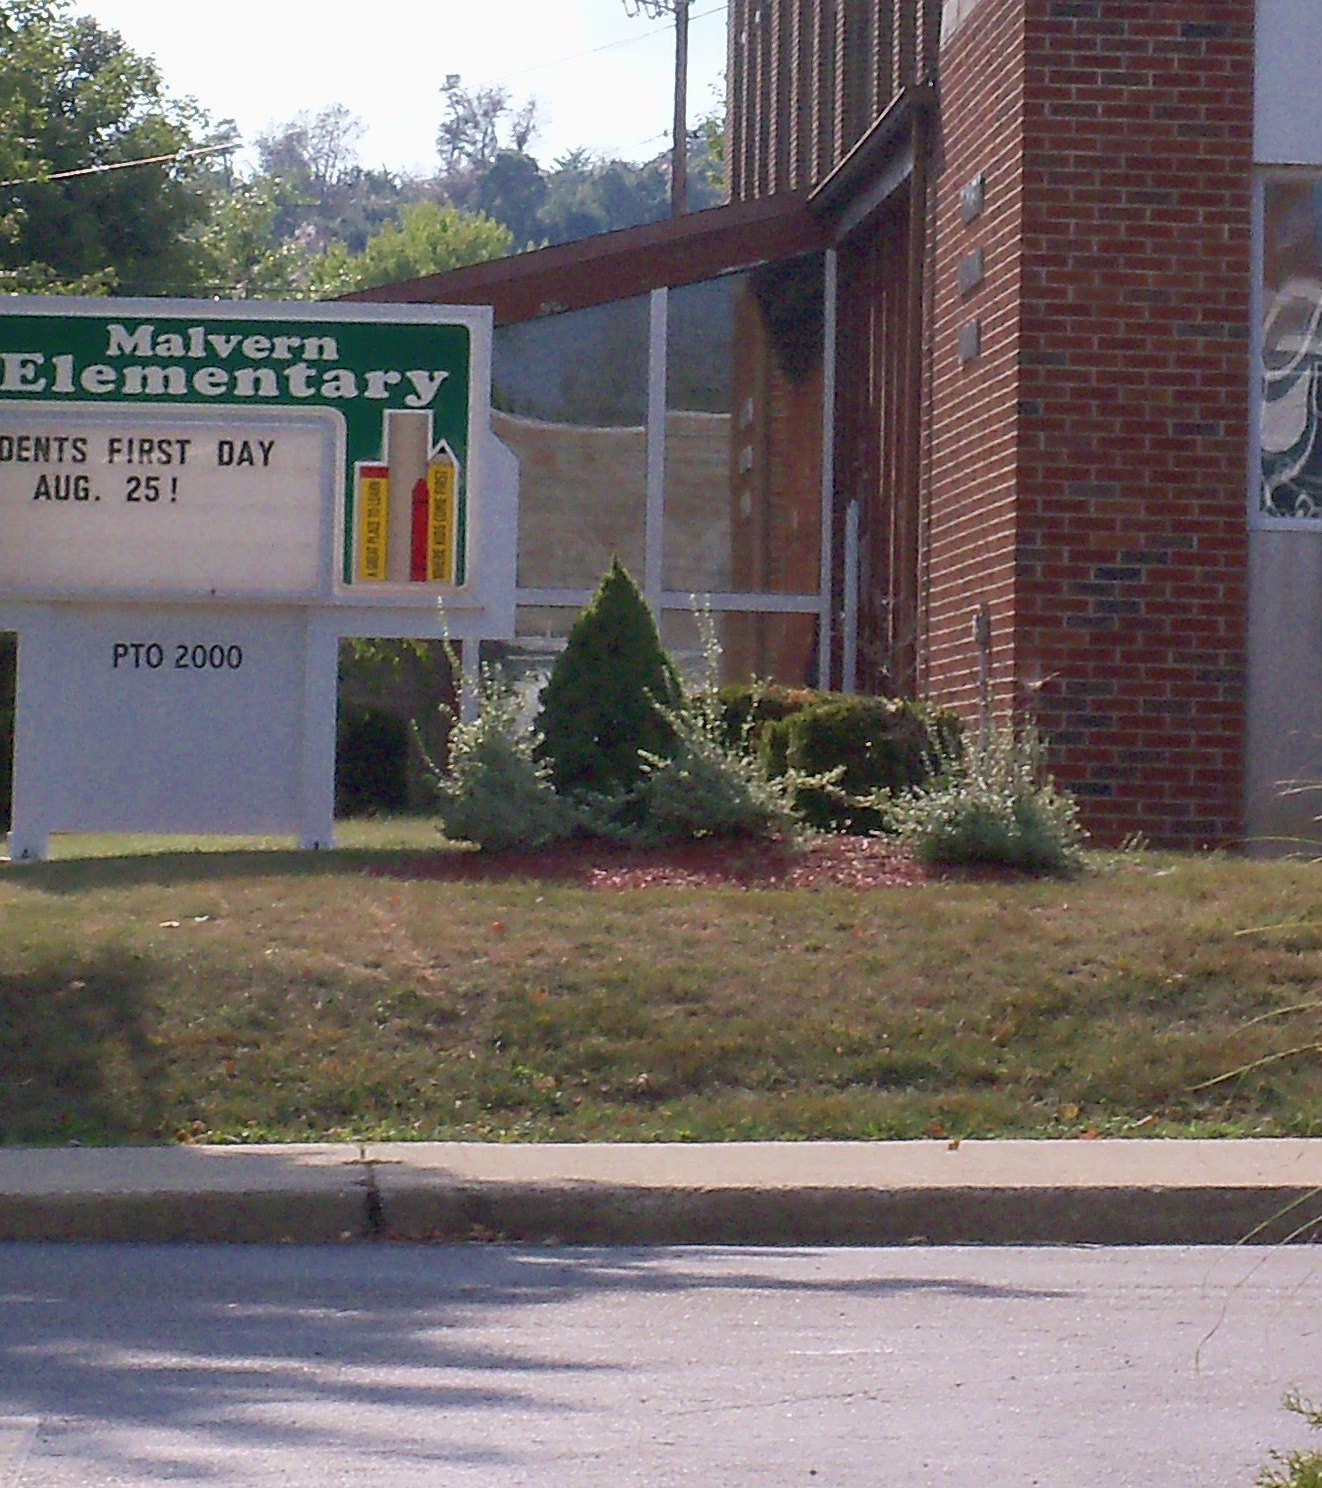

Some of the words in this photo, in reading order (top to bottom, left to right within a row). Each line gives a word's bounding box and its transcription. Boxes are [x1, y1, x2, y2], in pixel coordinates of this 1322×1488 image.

[106, 323, 339, 362] Malvern
[0, 352, 449, 408] Elementary
[108, 438, 192, 465] FIRST
[217, 440, 275, 467] DAY
[33, 474, 101, 502] AUG.
[113, 642, 164, 669] PTO
[175, 644, 243, 669] 2000
